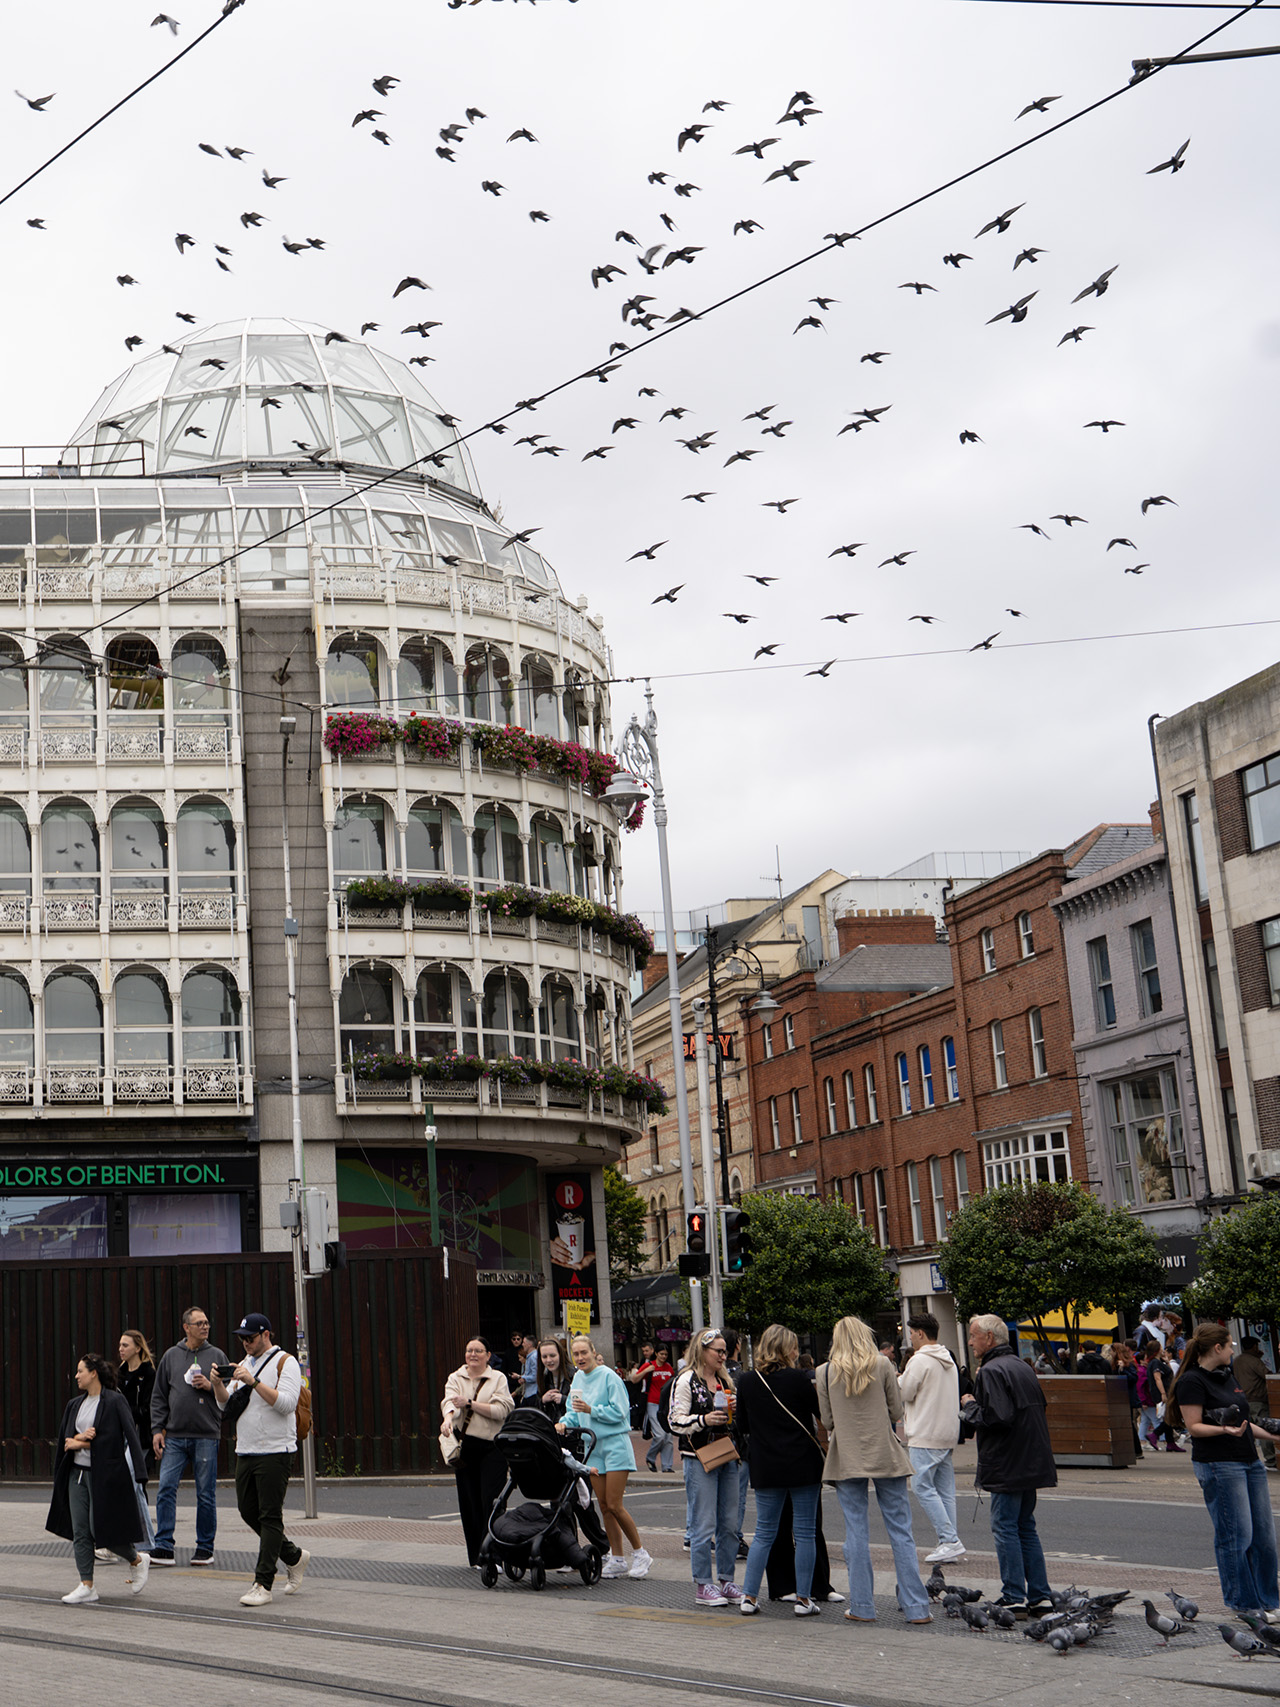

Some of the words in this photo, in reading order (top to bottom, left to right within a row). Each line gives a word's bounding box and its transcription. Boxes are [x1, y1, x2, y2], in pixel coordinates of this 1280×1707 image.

[66, 1165, 98, 1185] OF
[100, 1164, 225, 1184] BENETTON.
[564, 1185, 575, 1205] R
[569, 1234, 577, 1247] R
[558, 1287, 594, 1298] ROCKET'S
